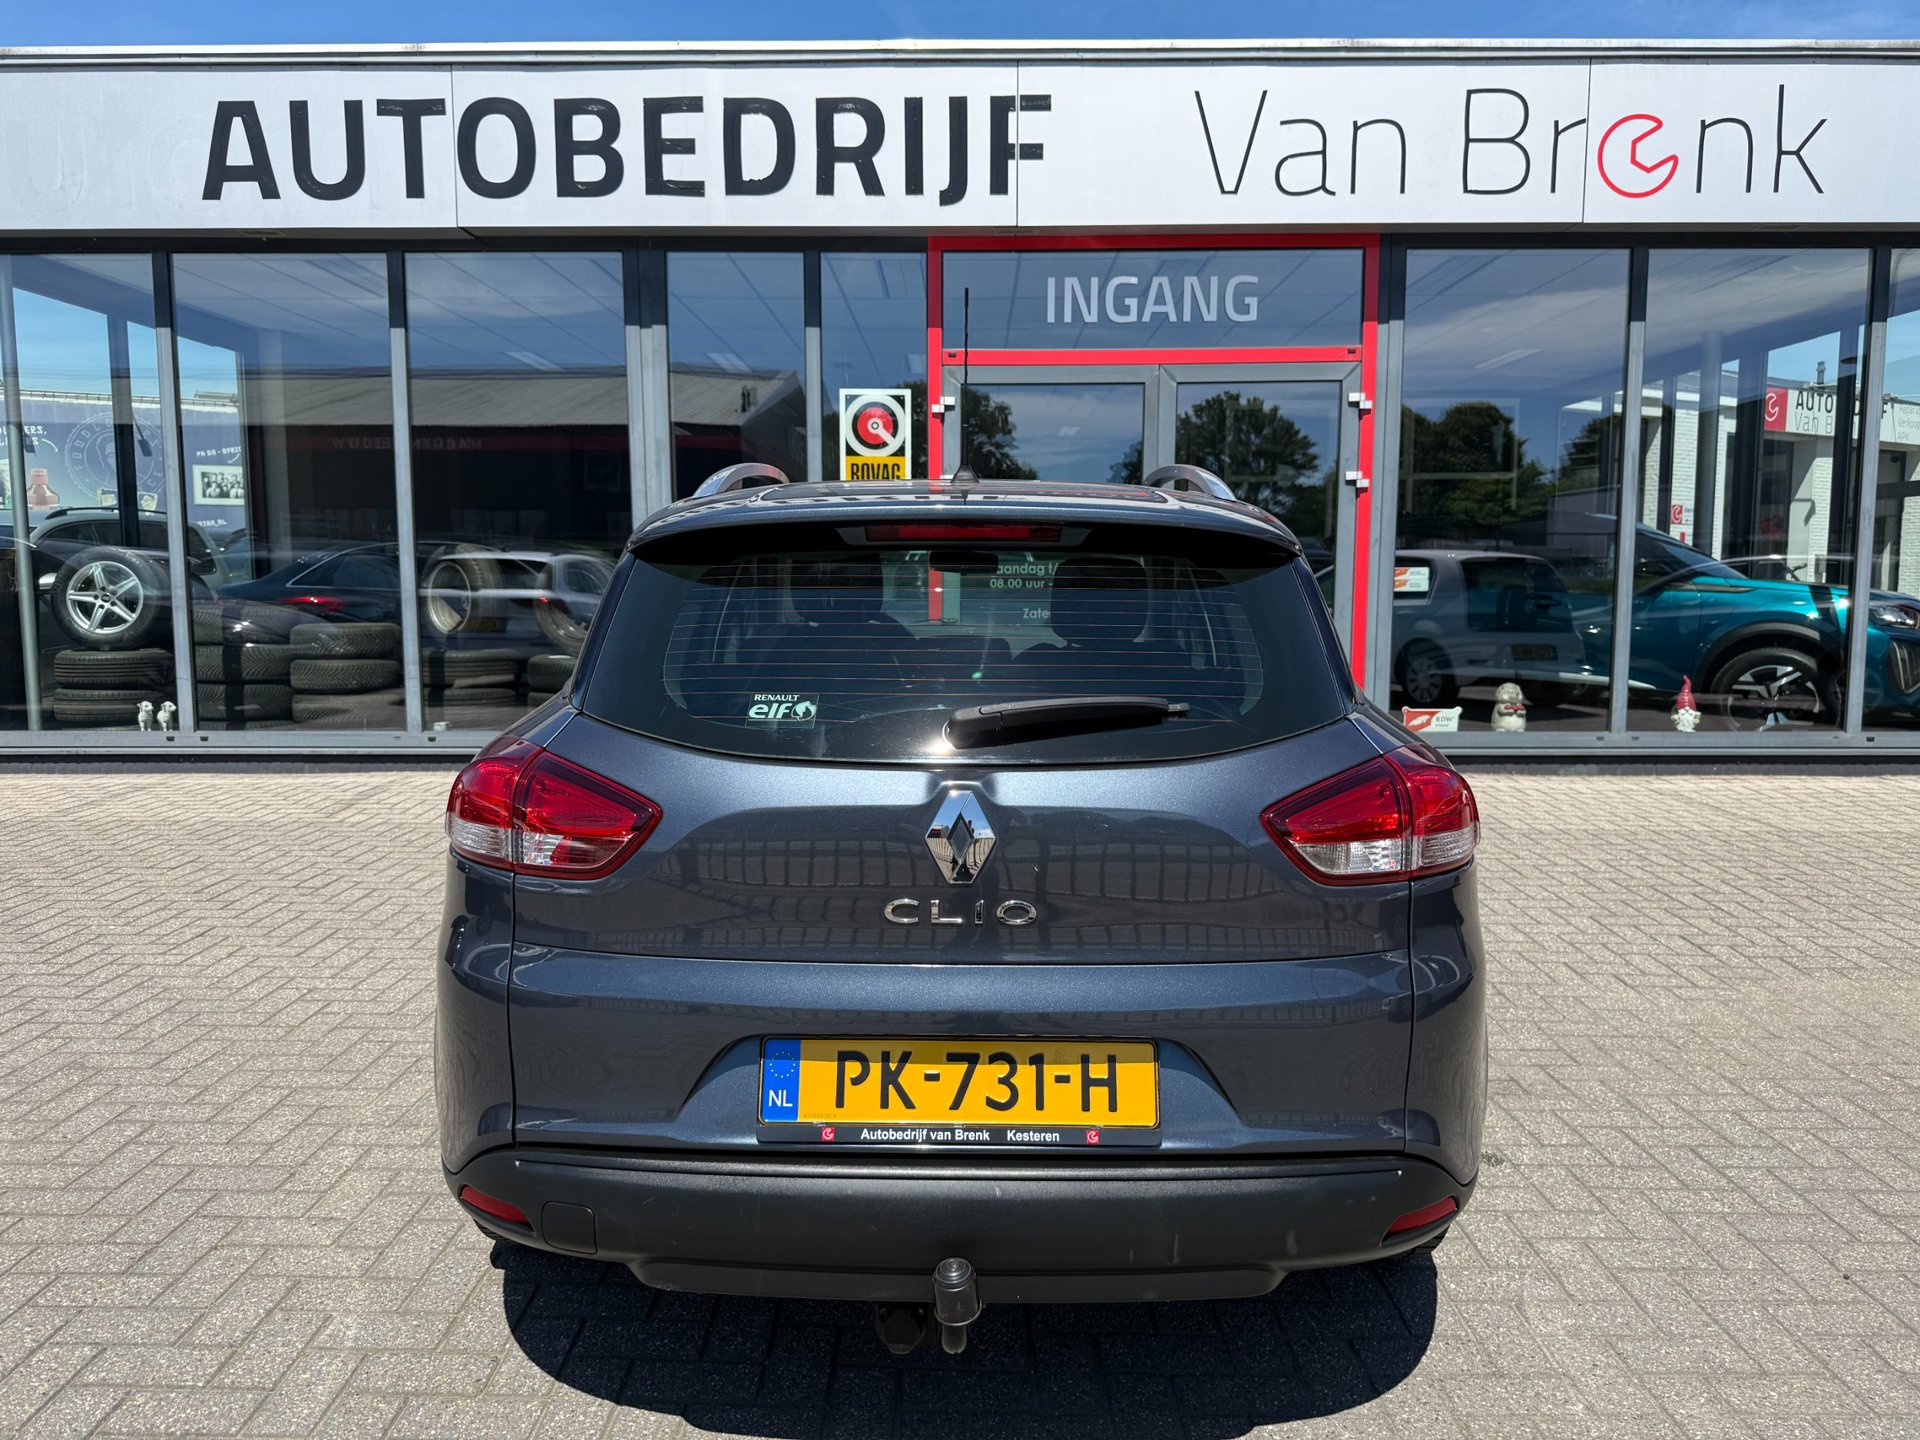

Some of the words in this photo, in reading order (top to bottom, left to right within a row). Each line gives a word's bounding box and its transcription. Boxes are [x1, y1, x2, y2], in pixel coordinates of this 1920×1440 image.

[202, 94, 1053, 207] AUTOBEDRIJF
[1194, 89, 1407, 197] Van
[1461, 83, 1828, 199] Brenk
[1046, 275, 1260, 324] INGANG
[997, 562, 1045, 577] aandag
[989, 578, 1022, 588] 08.00
[1025, 580, 1046, 588] uur
[753, 693, 800, 702] RENAULT
[748, 702, 793, 719] elf
[883, 898, 1038, 926] CLIO
[767, 1088, 793, 1108] NL
[834, 1049, 1118, 1113] PK-731-H
[860, 1127, 928, 1143] Autobedrijf
[929, 1131, 954, 1141] van
[954, 1128, 990, 1141] Brenk
[1006, 1129, 1060, 1142] Kesteren
